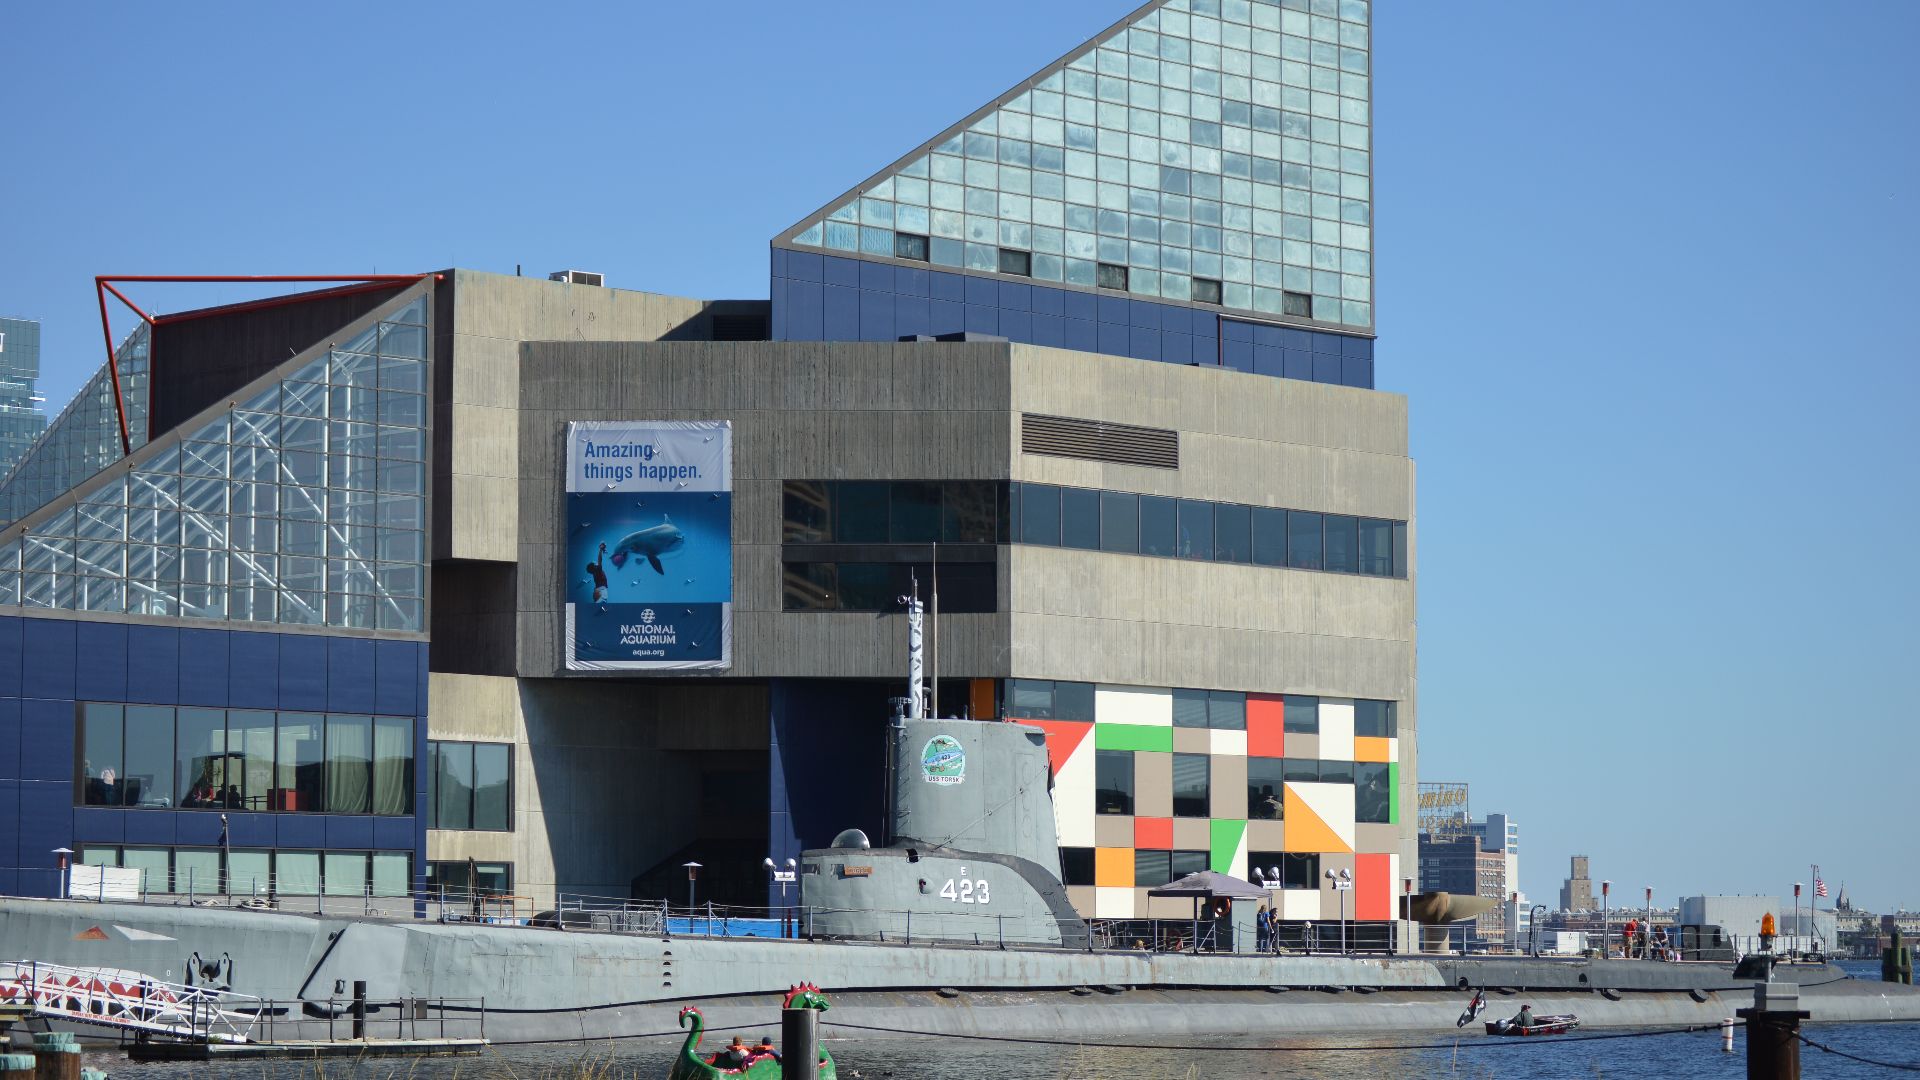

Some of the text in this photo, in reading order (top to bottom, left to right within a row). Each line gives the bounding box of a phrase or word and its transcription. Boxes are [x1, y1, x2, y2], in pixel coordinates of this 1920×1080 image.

[584, 441, 653, 461] Amazing
[584, 462, 702, 482] things happen.
[620, 624, 676, 634] NATIONAL
[620, 635, 676, 645] AQUARIUM
[632, 649, 665, 657] aqua.org
[960, 866, 967, 876] E
[939, 878, 991, 904] 423
